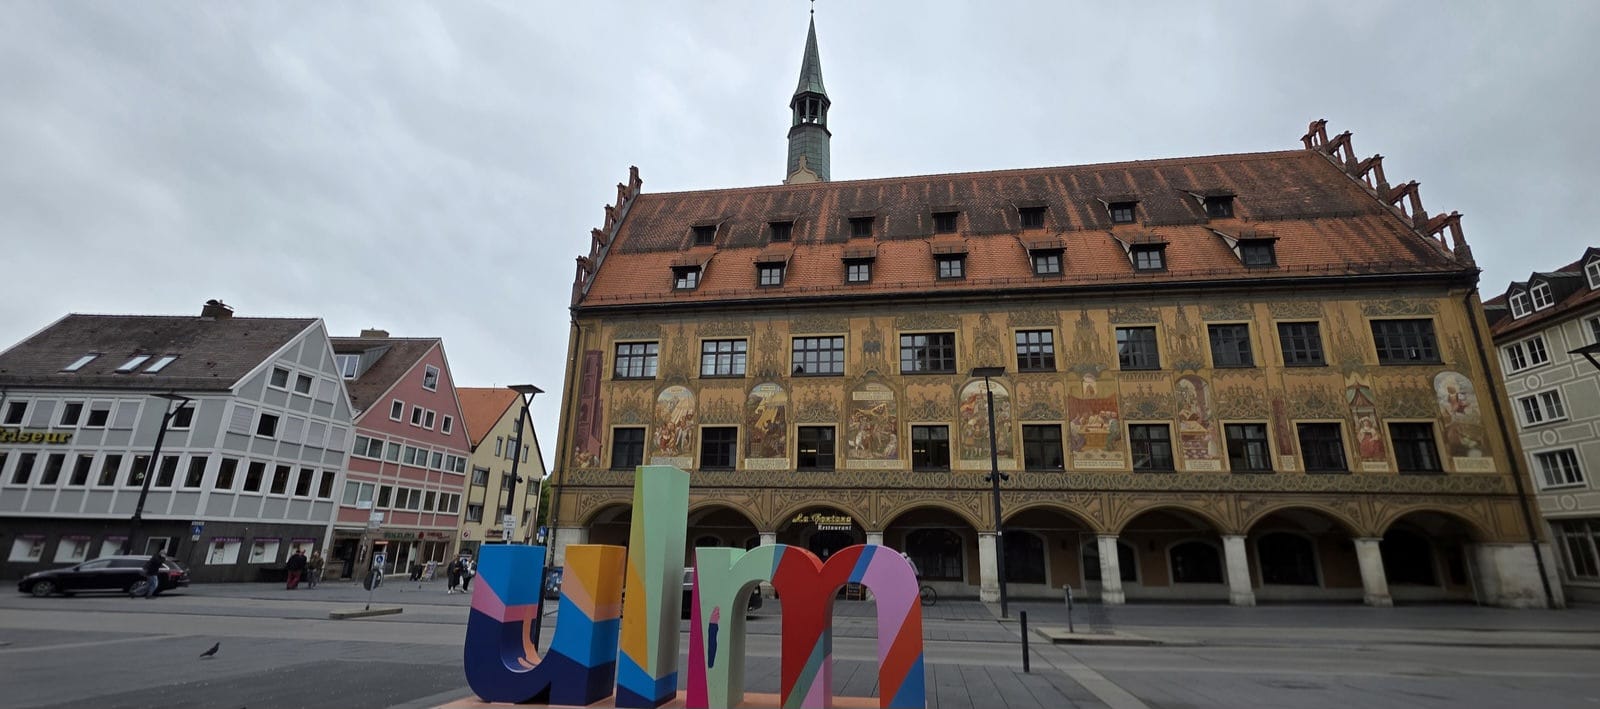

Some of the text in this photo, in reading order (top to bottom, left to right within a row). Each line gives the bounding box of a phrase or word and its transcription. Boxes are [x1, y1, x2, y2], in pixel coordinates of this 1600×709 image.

[792, 513, 852, 525] La Fontana
[463, 465, 926, 709] ulm
